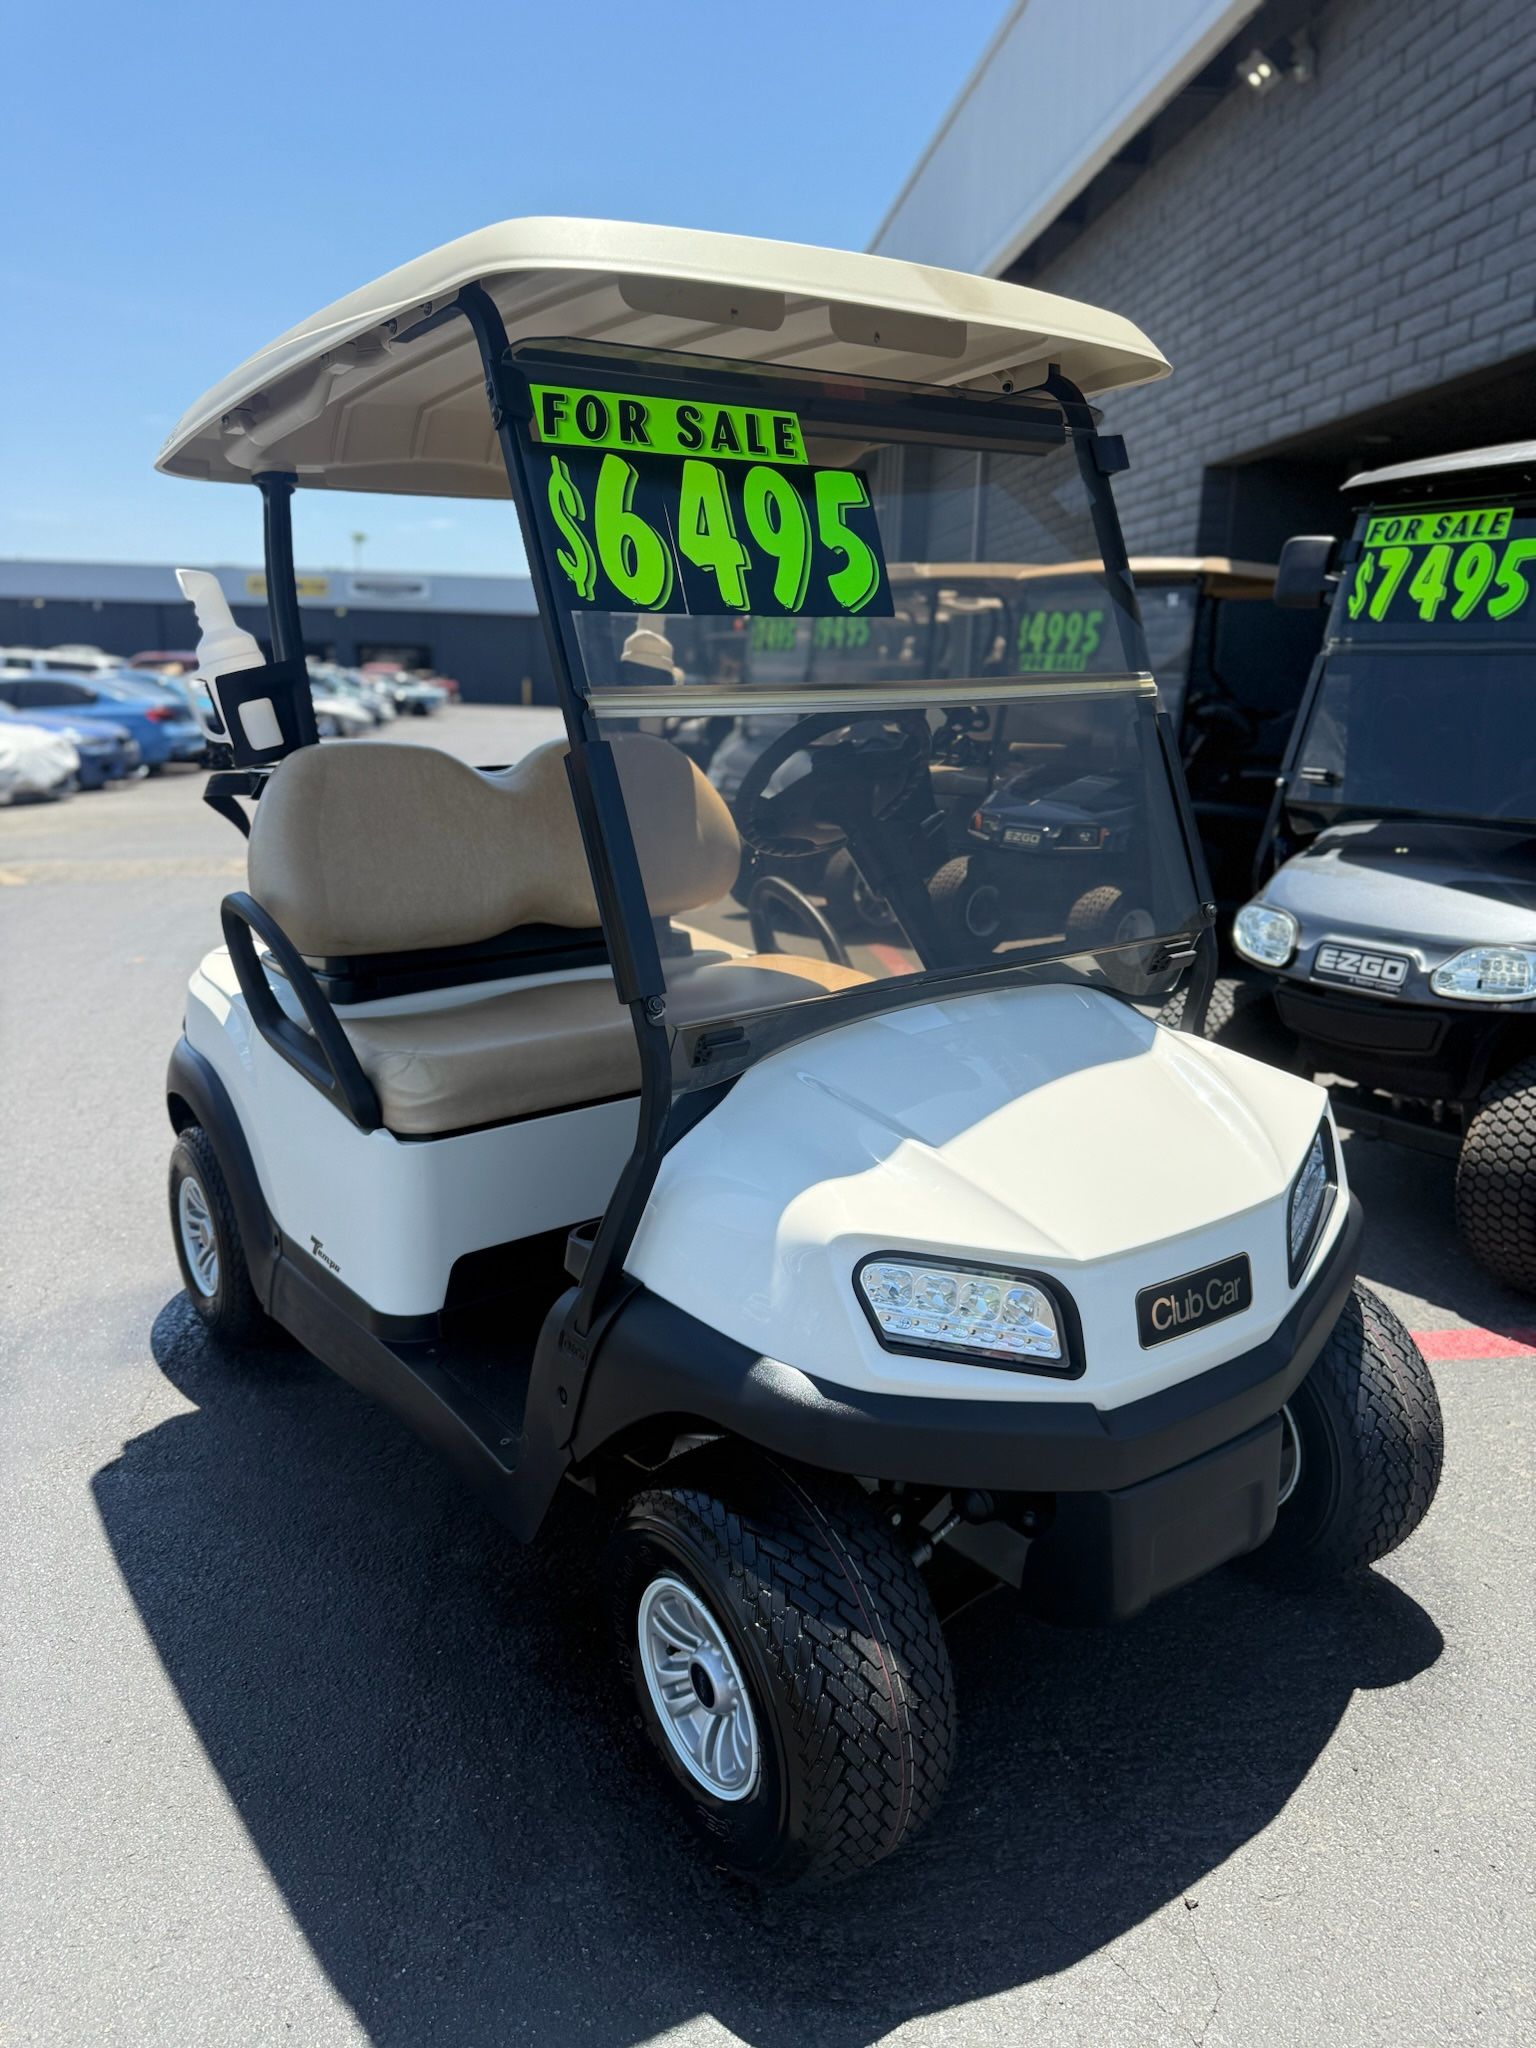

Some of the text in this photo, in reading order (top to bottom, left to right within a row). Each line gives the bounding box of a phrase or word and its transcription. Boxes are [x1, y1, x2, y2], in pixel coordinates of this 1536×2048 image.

[541, 391, 797, 457] FOR SALE
[548, 453, 880, 612] $6495
[1367, 512, 1511, 544] FOR SALE
[1348, 538, 1536, 622] $7495
[310, 1234, 341, 1273] Tempo
[1151, 1277, 1241, 1331] Club Car
